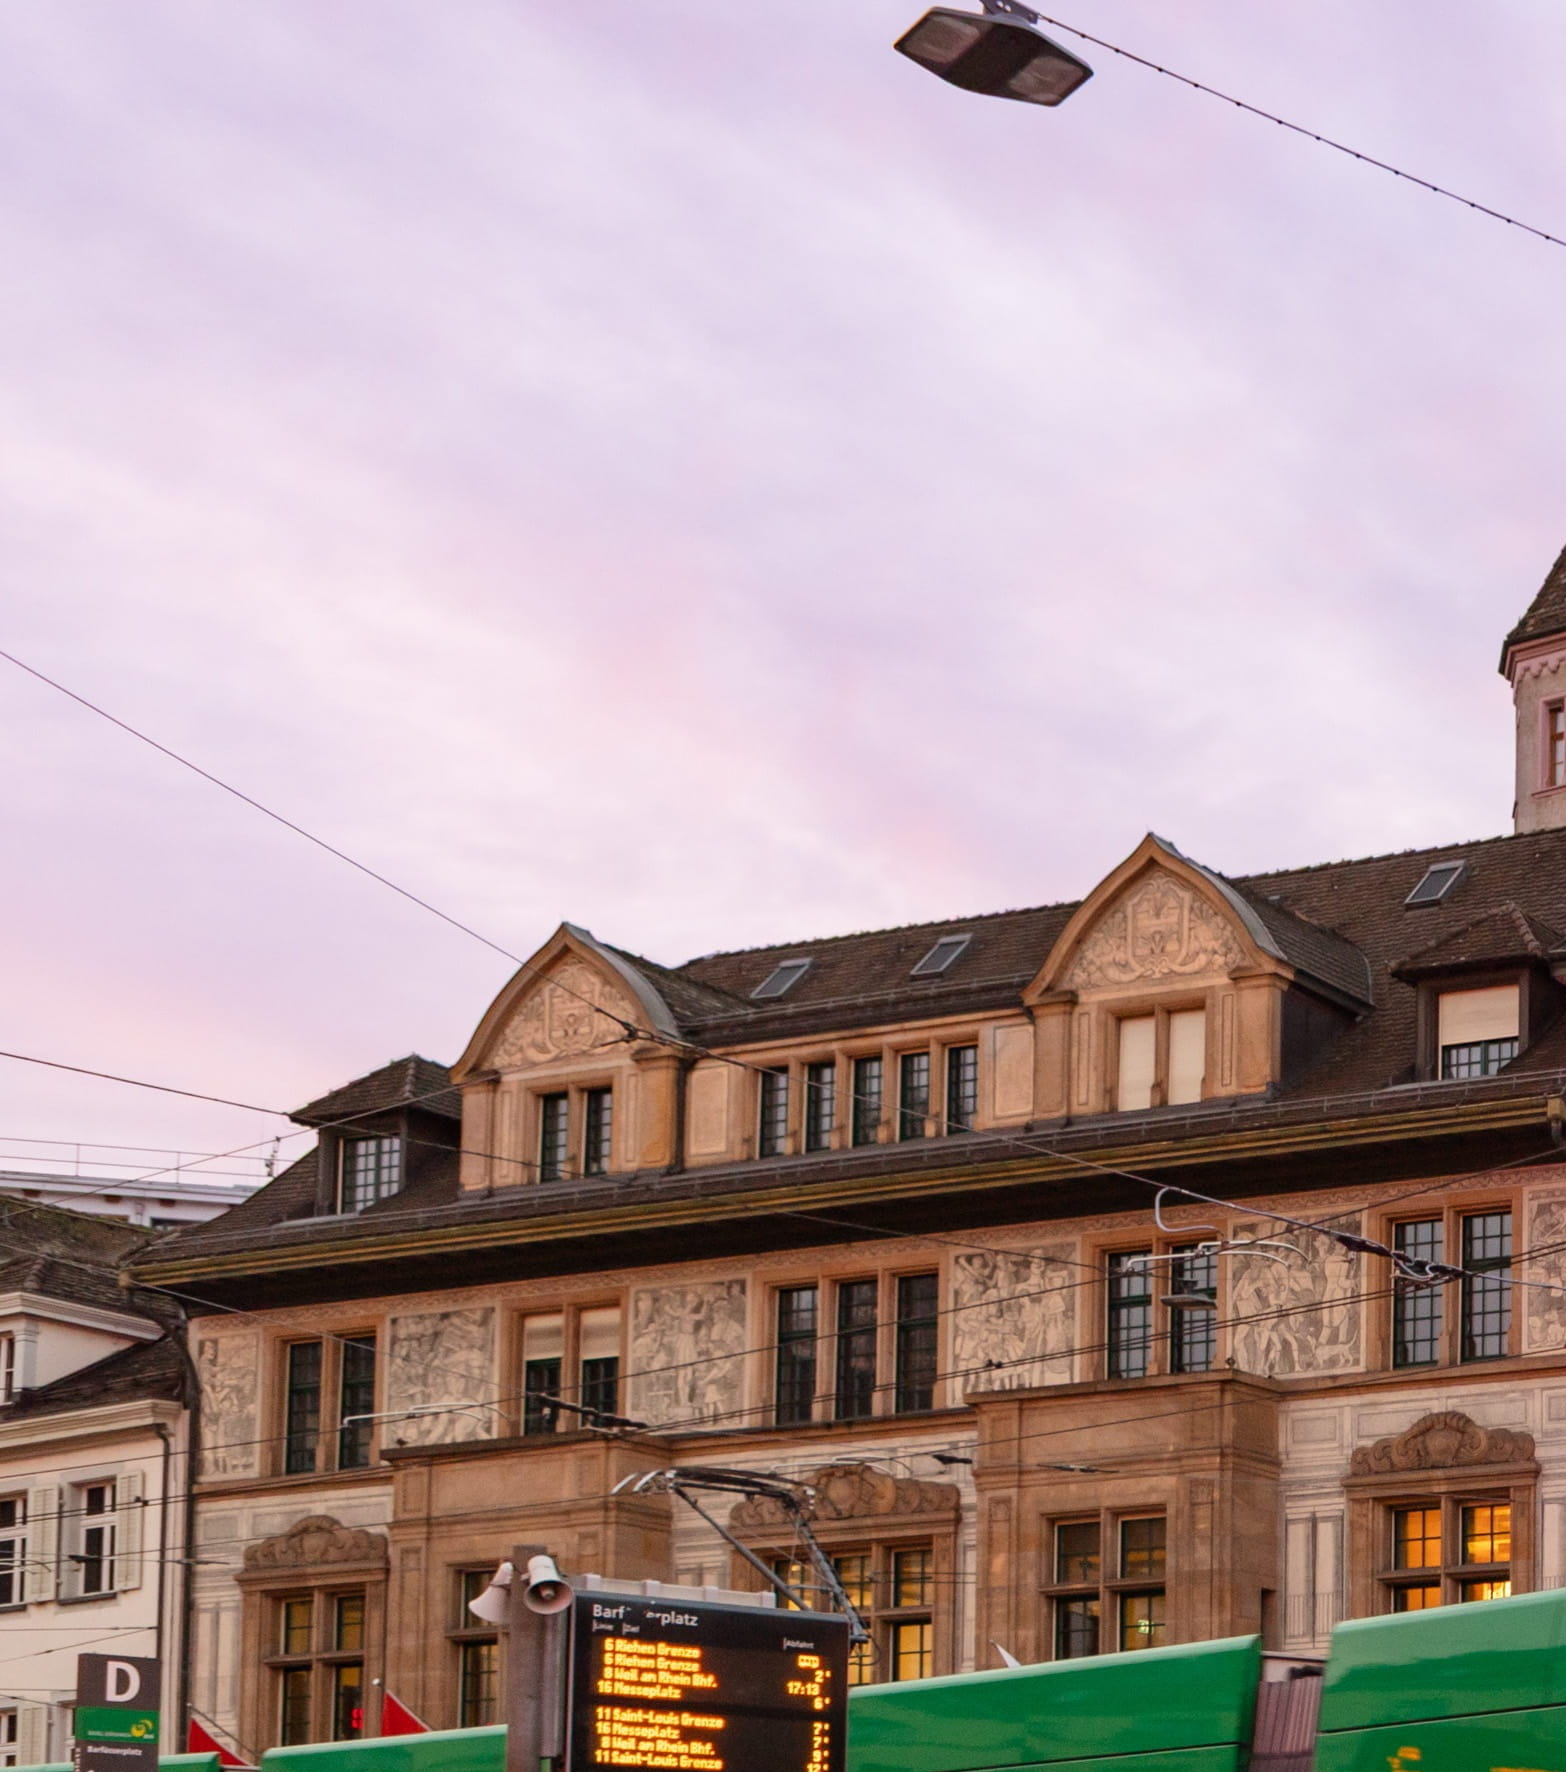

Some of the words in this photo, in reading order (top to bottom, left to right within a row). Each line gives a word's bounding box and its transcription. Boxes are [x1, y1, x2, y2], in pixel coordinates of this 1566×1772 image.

[592, 1603, 699, 1627] Barferplatz
[604, 1638, 614, 1651] 6
[614, 1639, 656, 1655] Riehen
[657, 1642, 702, 1659] Grenze
[604, 1652, 614, 1665] 6
[614, 1653, 656, 1669] Riehen
[656, 1656, 700, 1672] Grenze
[105, 1660, 141, 1703] D
[597, 1679, 612, 1694] 16
[613, 1681, 682, 1699] Messeplatz
[603, 1666, 613, 1679] 8
[614, 1667, 639, 1682] Weil
[657, 1670, 691, 1686] Rhein
[692, 1673, 718, 1688] Bhf.
[786, 1681, 821, 1695] 17:13
[595, 1706, 611, 1721] 11
[612, 1707, 680, 1726] Saint-Louis
[681, 1712, 725, 1729] Grenze
[595, 1720, 611, 1735] 16
[612, 1722, 681, 1740] Messeplatz
[601, 1735, 611, 1749] 8
[611, 1736, 636, 1751] Weil
[655, 1739, 689, 1754] Rhein
[689, 1741, 716, 1756] Bhf.
[594, 1749, 610, 1763] 11
[610, 1750, 679, 1767] Saint-Louis
[679, 1755, 723, 1771] Grenze
